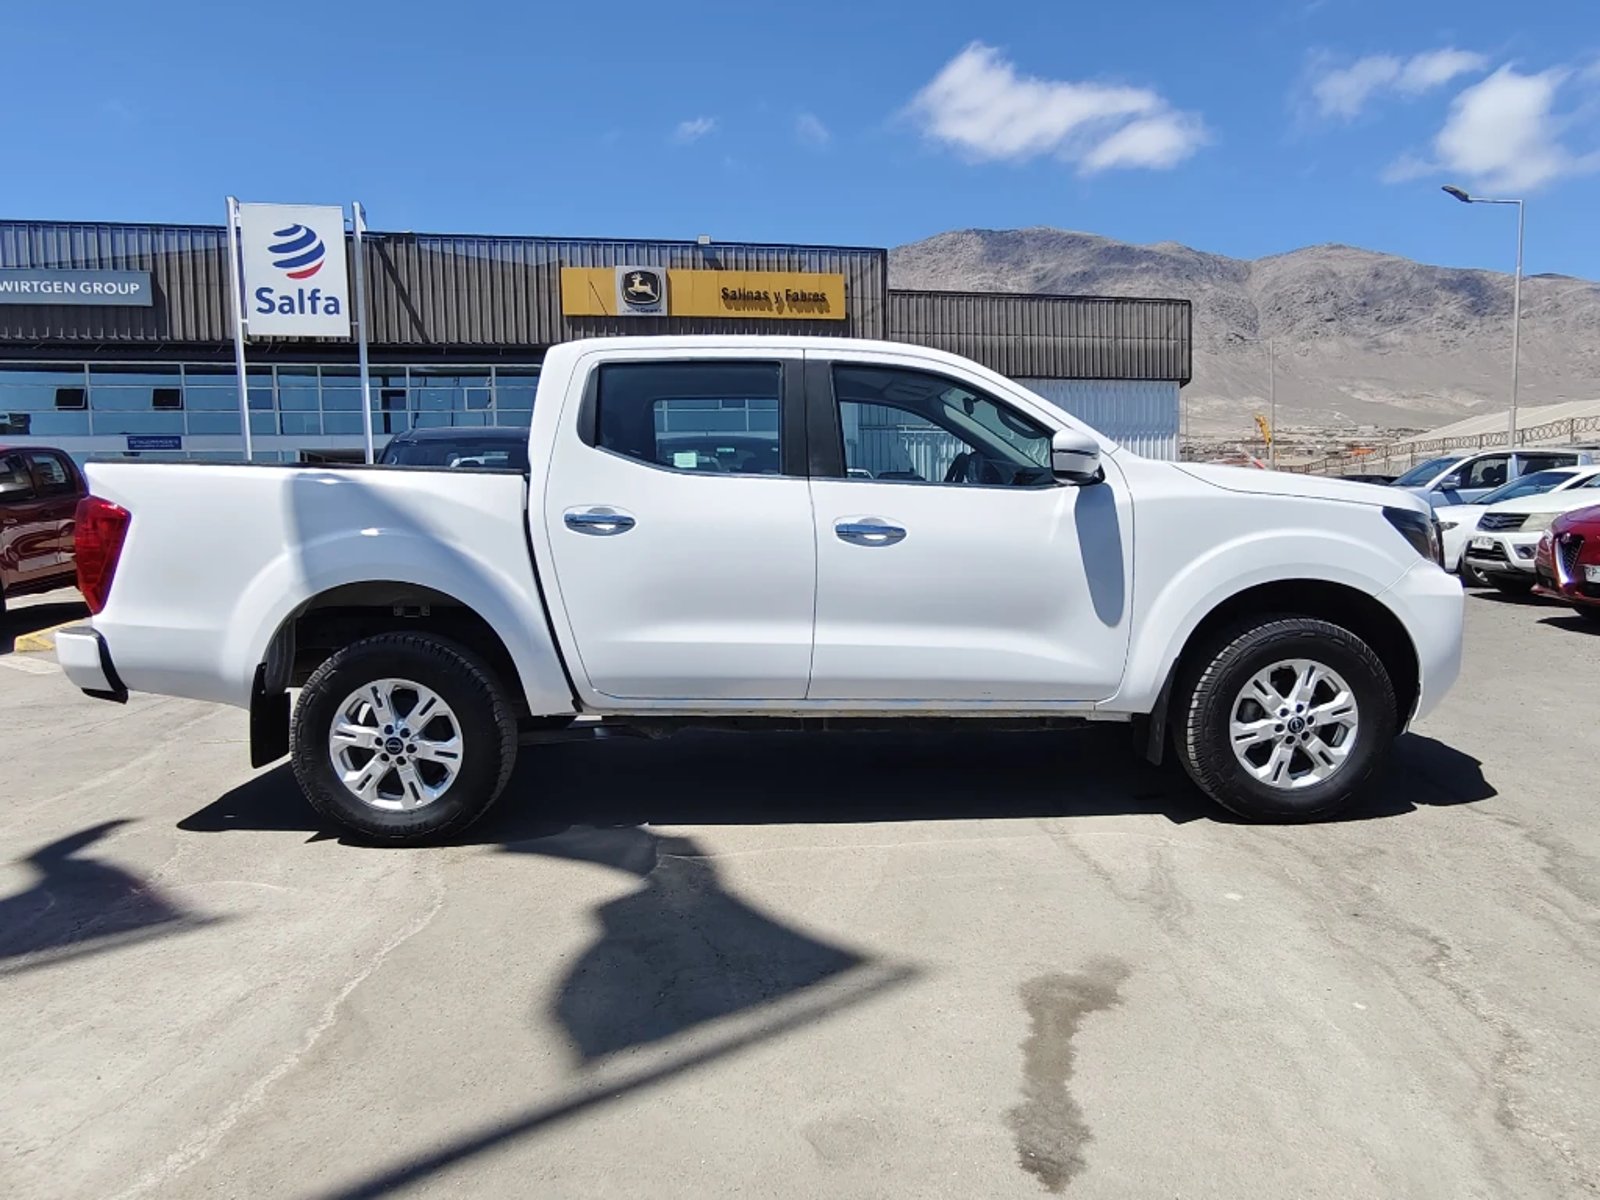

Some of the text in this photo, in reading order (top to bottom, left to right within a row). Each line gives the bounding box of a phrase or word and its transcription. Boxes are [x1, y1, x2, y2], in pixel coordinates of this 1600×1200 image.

[0, 280, 140, 295] WIRTGEN GROUP
[721, 287, 826, 304] Salinas y Fabres
[255, 287, 341, 315] Salfa
